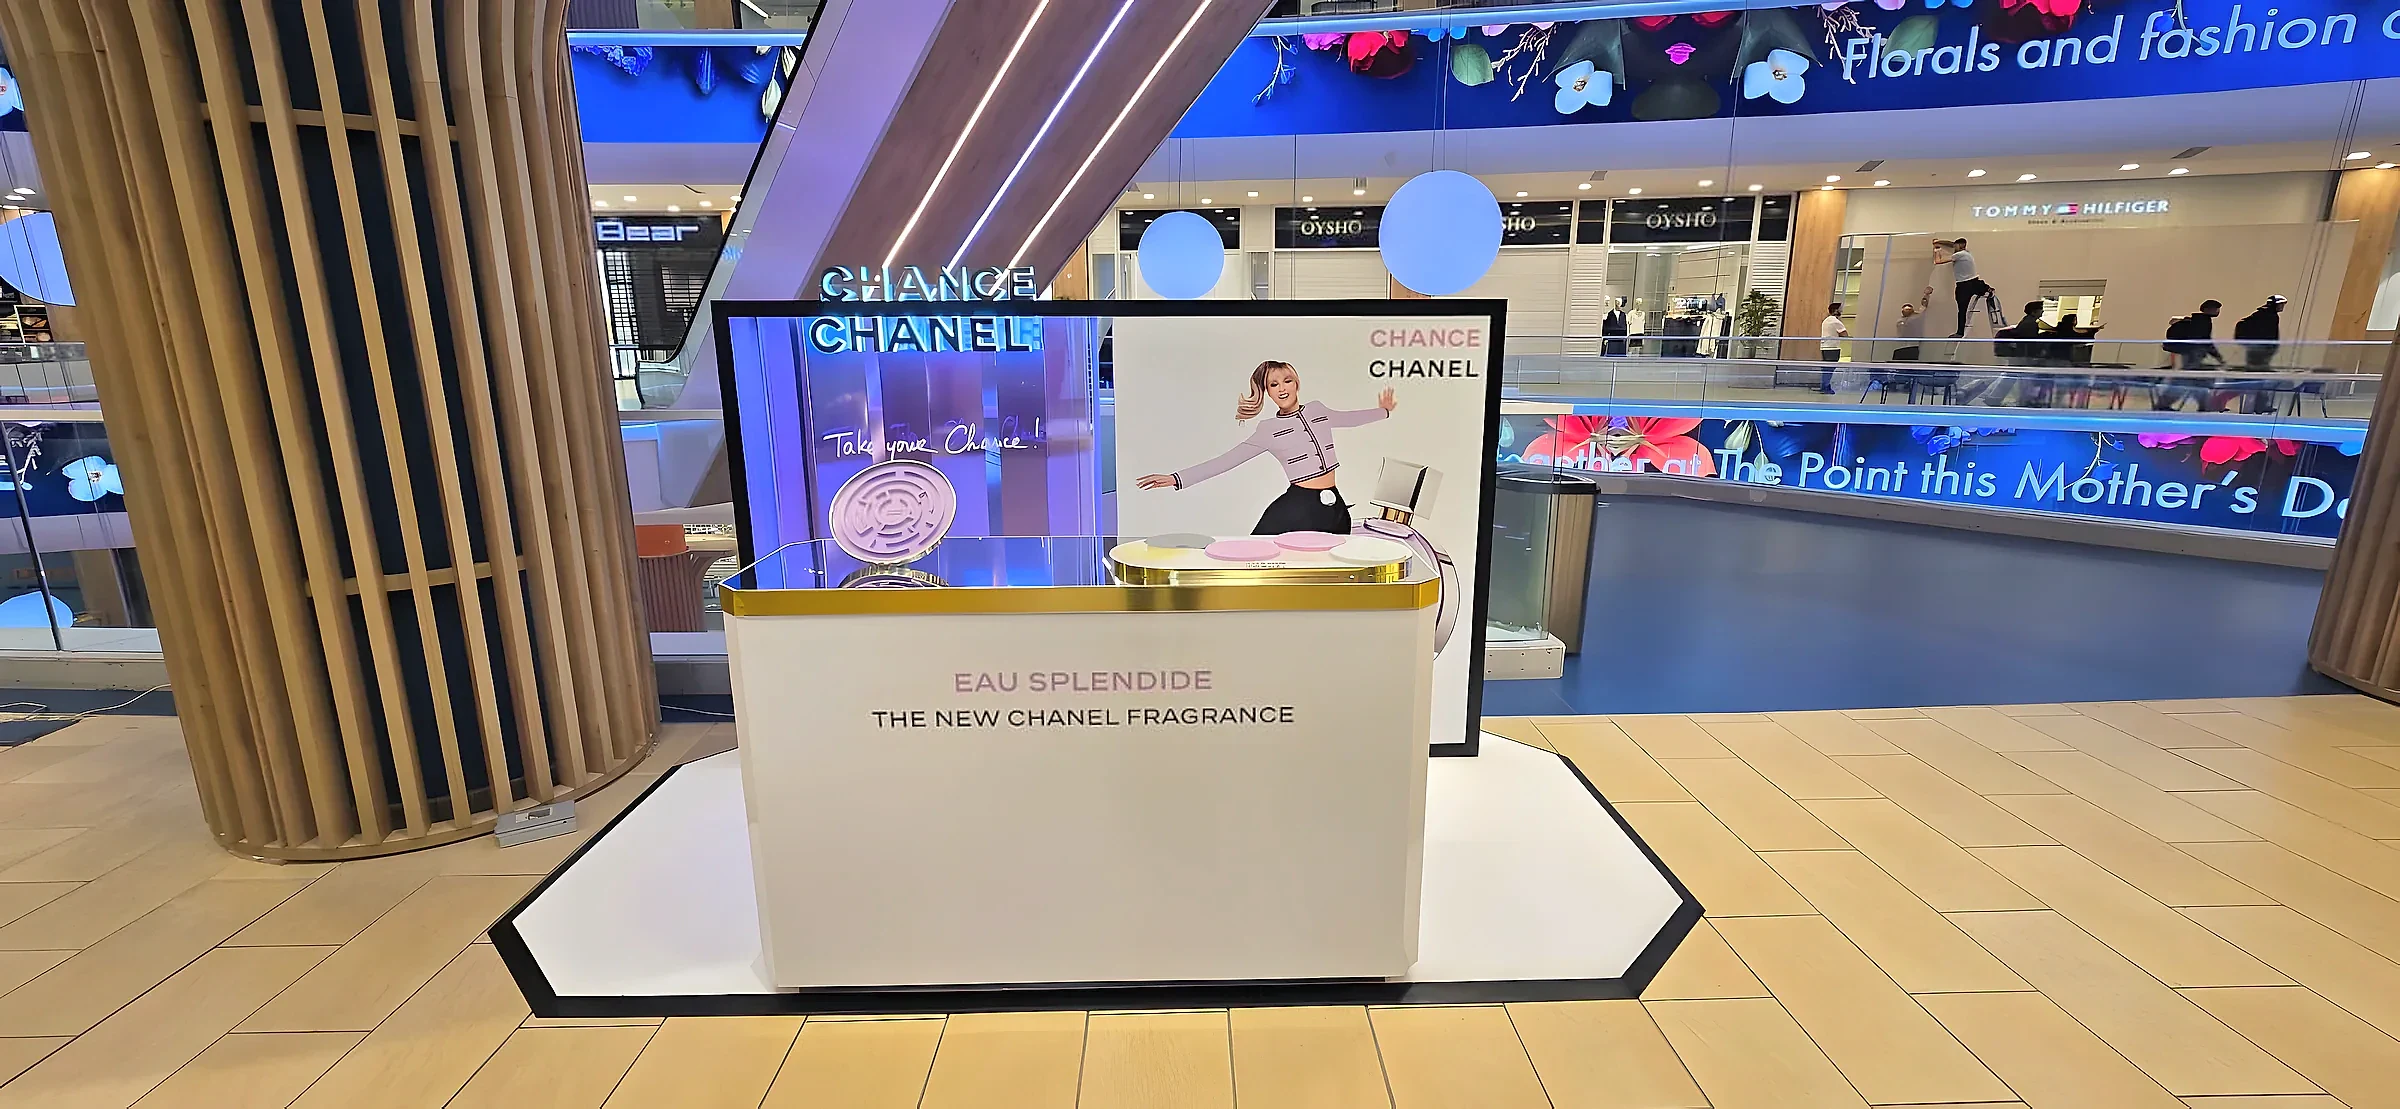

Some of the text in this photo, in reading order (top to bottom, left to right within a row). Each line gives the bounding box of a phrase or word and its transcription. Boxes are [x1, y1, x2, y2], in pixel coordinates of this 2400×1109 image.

[1842, 25, 2000, 80] Florals
[2017, 15, 2124, 69] and
[2138, 4, 2357, 61] fashion
[1972, 200, 2169, 218] TOMMY HILFIGER
[596, 220, 699, 241] Bear
[1300, 219, 1362, 236] OYSHO
[1502, 216, 1536, 231] SHO
[1645, 211, 1718, 230] OYSHO
[819, 266, 1038, 302] CHANCE
[809, 316, 1034, 353] CHANEL
[1369, 328, 1481, 348] CHANCE
[1368, 359, 1480, 378] CHANEL
[1662, 453, 1702, 476] at
[1713, 448, 1783, 486] The
[1798, 451, 1909, 492] Point
[1920, 454, 1997, 498] this
[2014, 460, 2259, 515] Mother's
[954, 670, 1213, 693] EAU SPLENDIDE
[871, 706, 1295, 728] THE NEW CHANEL FRAGRANCE
